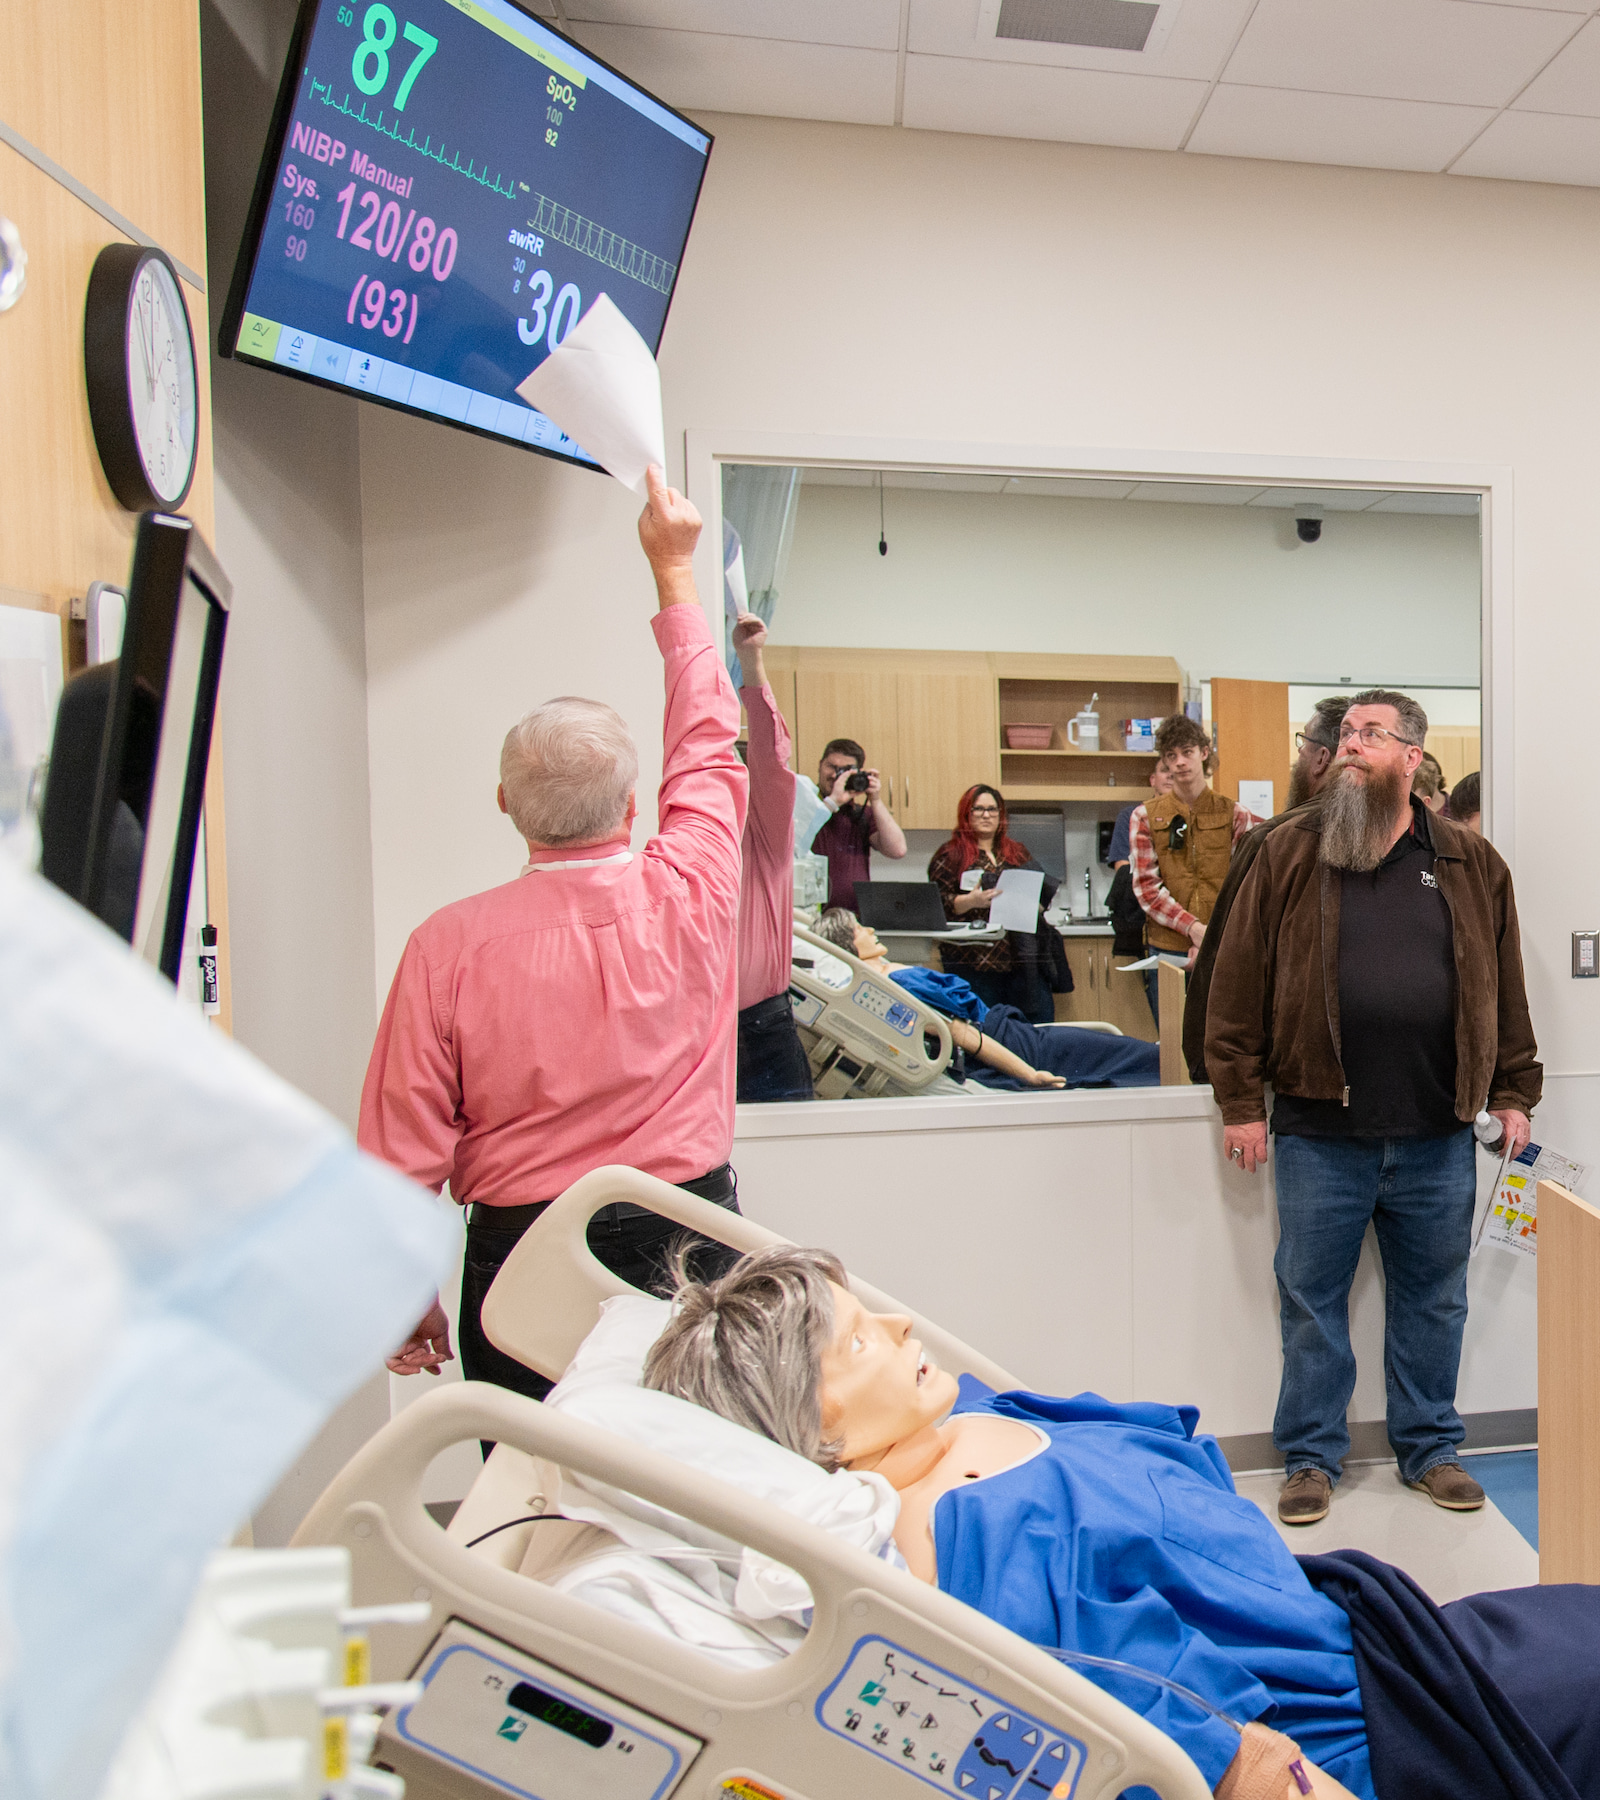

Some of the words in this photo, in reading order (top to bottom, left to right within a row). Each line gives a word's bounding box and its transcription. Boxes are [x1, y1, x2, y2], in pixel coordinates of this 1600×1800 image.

[337, 5, 353, 27] 50
[351, 2, 439, 112] 87
[546, 105, 563, 126] 100
[545, 128, 558, 147] 92
[291, 121, 347, 167] NIBP
[349, 149, 414, 199] Manual
[283, 163, 320, 201] Sys.
[285, 200, 315, 231] 160
[336, 181, 458, 282] 120/80
[508, 229, 545, 257] awRR
[284, 235, 307, 262] 90
[512, 257, 526, 274] 30
[141, 279, 151, 304] 12
[513, 279, 521, 294] 8
[347, 274, 418, 344] (93)
[517, 269, 581, 354] 30
[166, 339, 172, 362] 2
[171, 383, 177, 405] 3
[203, 957, 216, 984] EXPO
